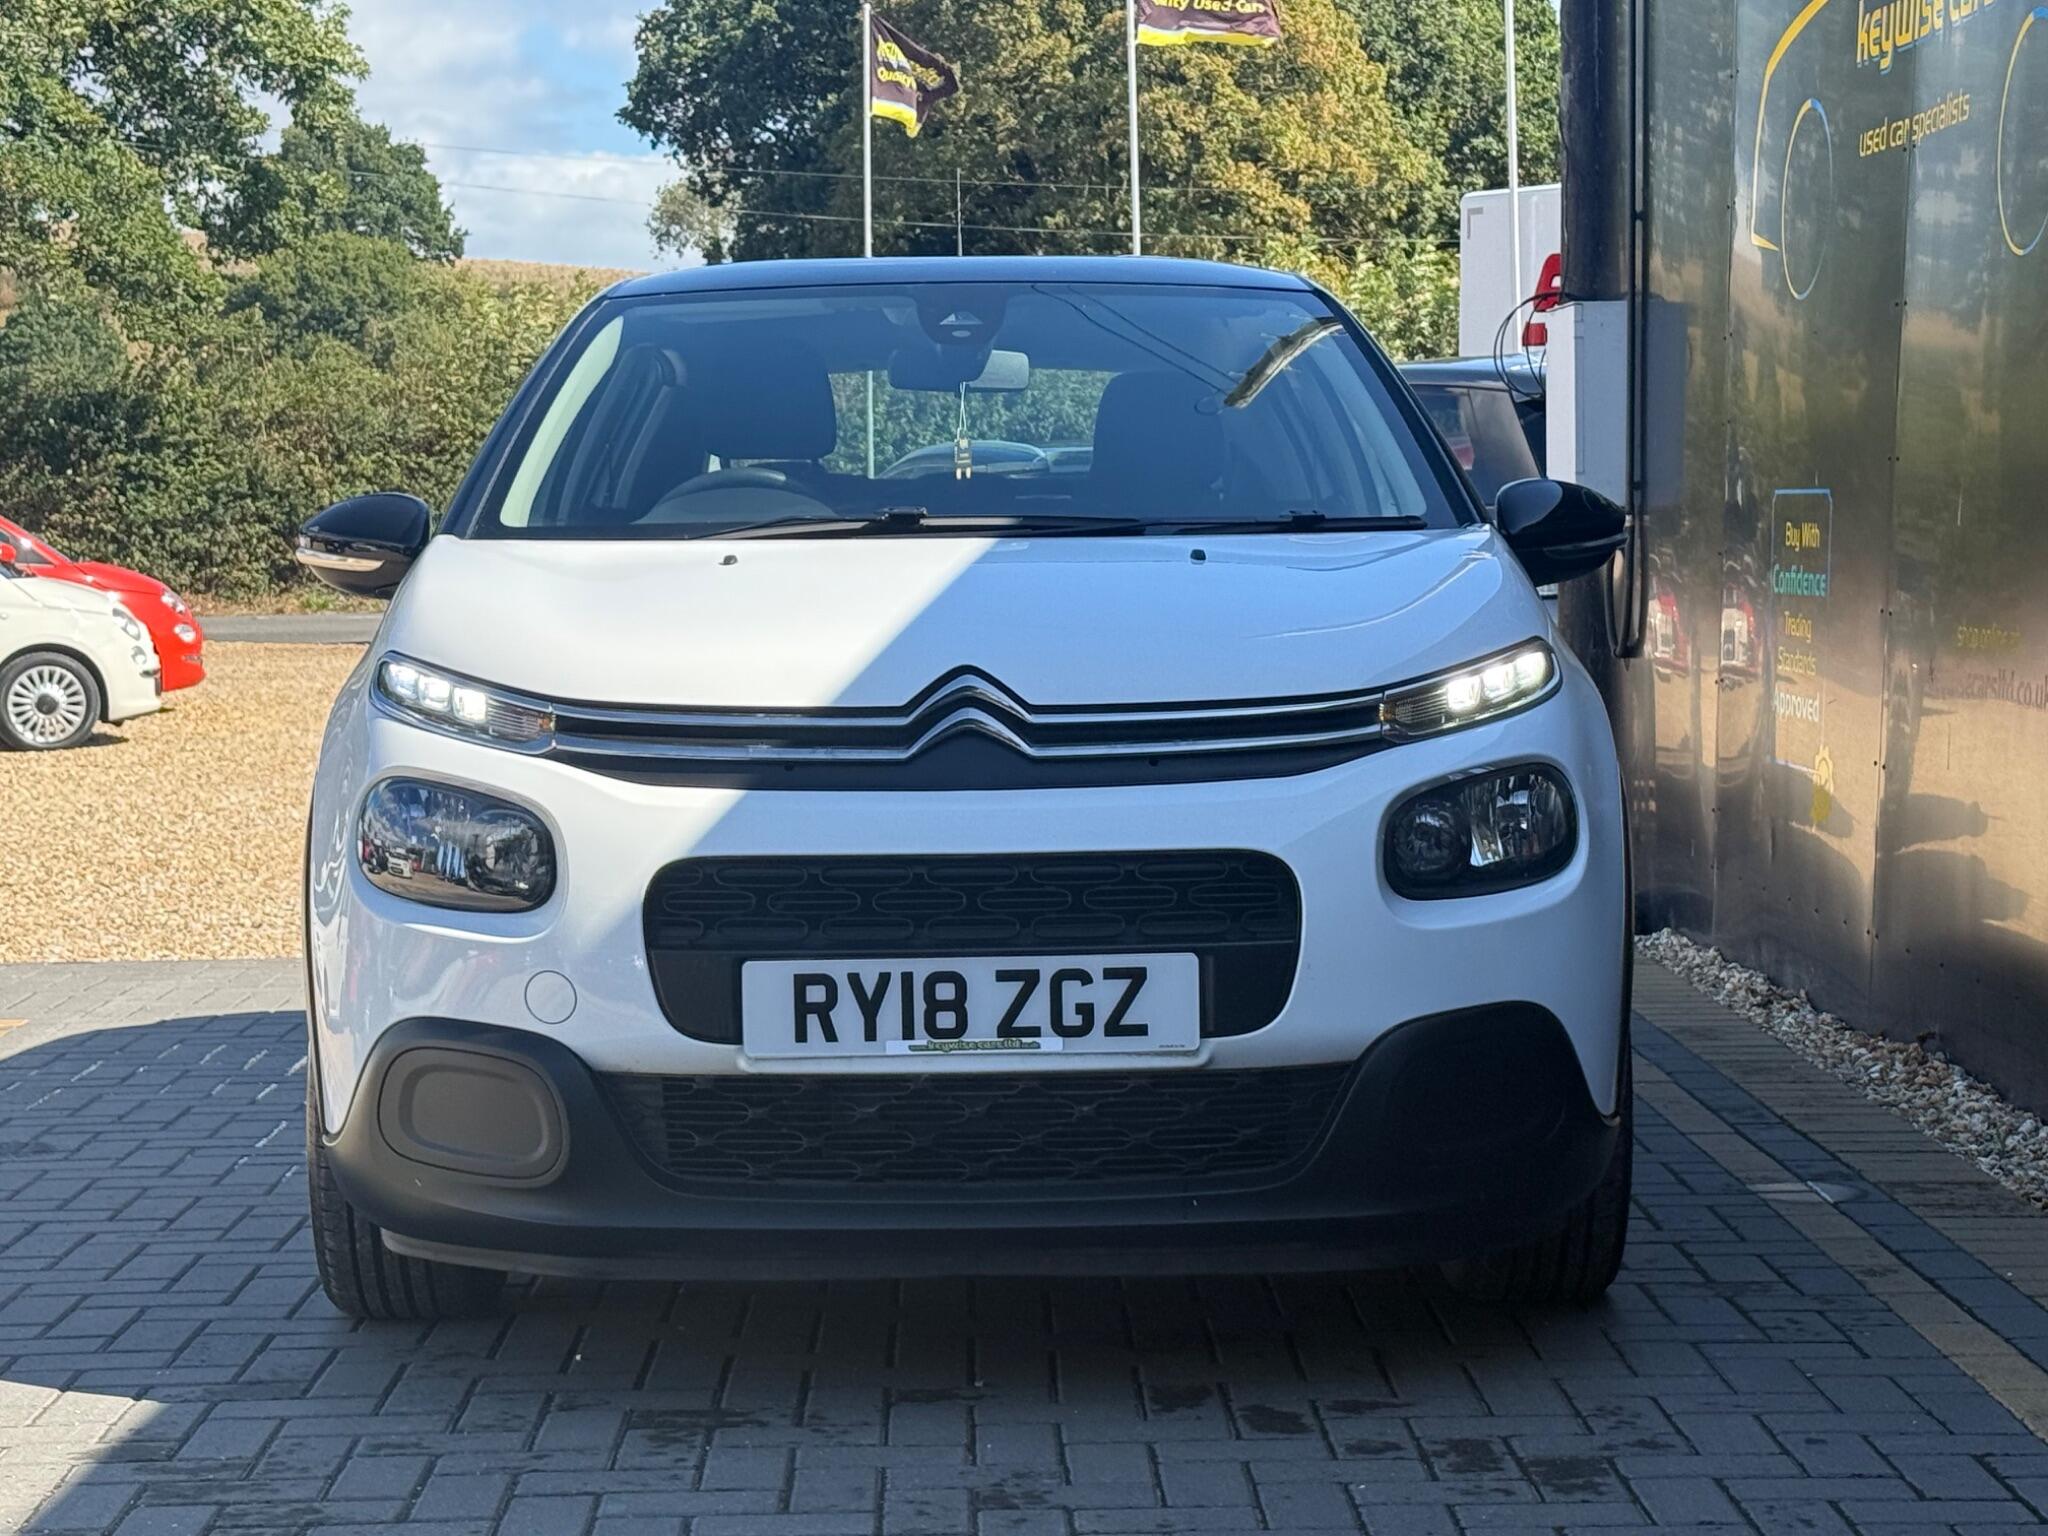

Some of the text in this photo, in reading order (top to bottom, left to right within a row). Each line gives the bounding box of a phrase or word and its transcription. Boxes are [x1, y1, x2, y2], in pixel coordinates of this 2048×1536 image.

[1859, 87, 1970, 157] used car specialists
[1785, 521, 1821, 552] Buy With
[1773, 563, 1827, 597] Confidence
[1784, 610, 1812, 644] Trading
[1773, 686, 1820, 723] Approved
[792, 967, 1149, 1043] RY18 ZGZ
